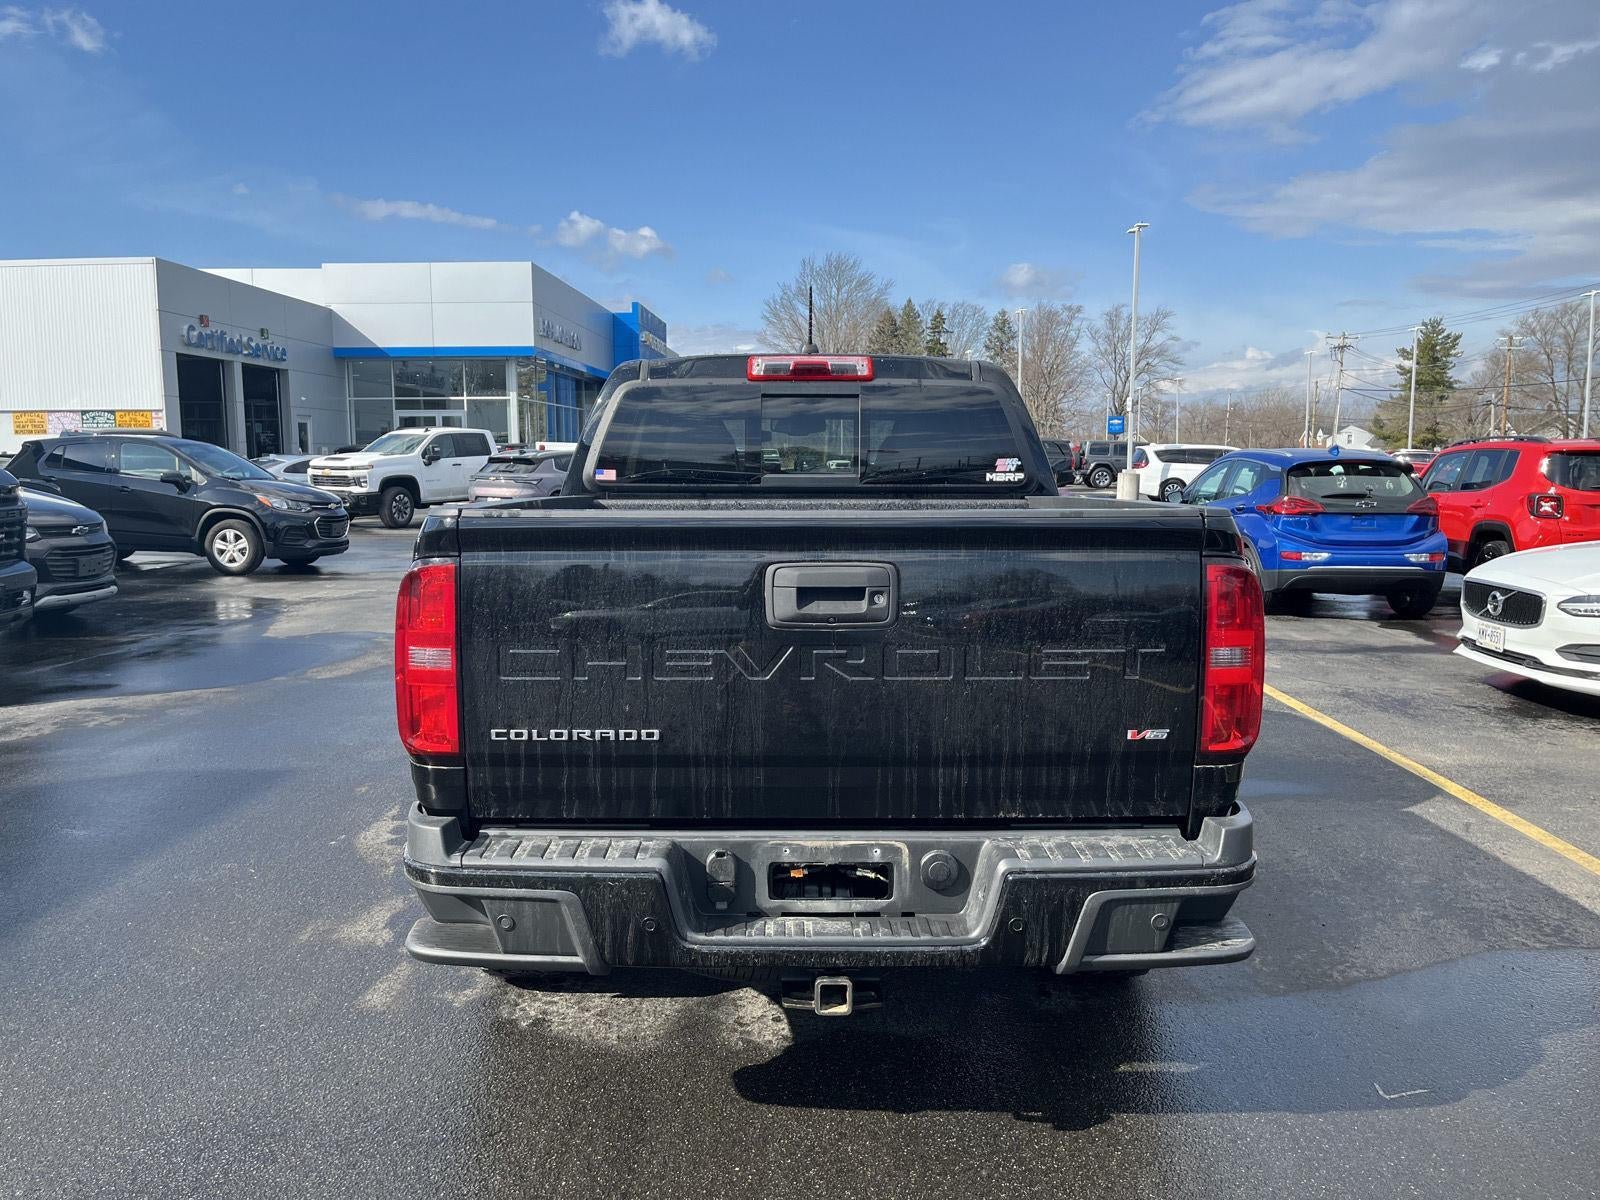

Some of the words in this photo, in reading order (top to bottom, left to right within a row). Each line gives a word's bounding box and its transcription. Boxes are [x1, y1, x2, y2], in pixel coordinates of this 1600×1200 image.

[182, 323, 243, 354] Certified
[241, 336, 287, 361] Service
[15, 412, 44, 420] OFFICIAL
[82, 411, 115, 420] REGISTERED
[119, 411, 149, 420] OFFICIAL
[986, 472, 1025, 482] MBRP
[498, 645, 1166, 682] CHEVROLET
[490, 729, 661, 741] COLORADO
[1127, 729, 1170, 740] V6
